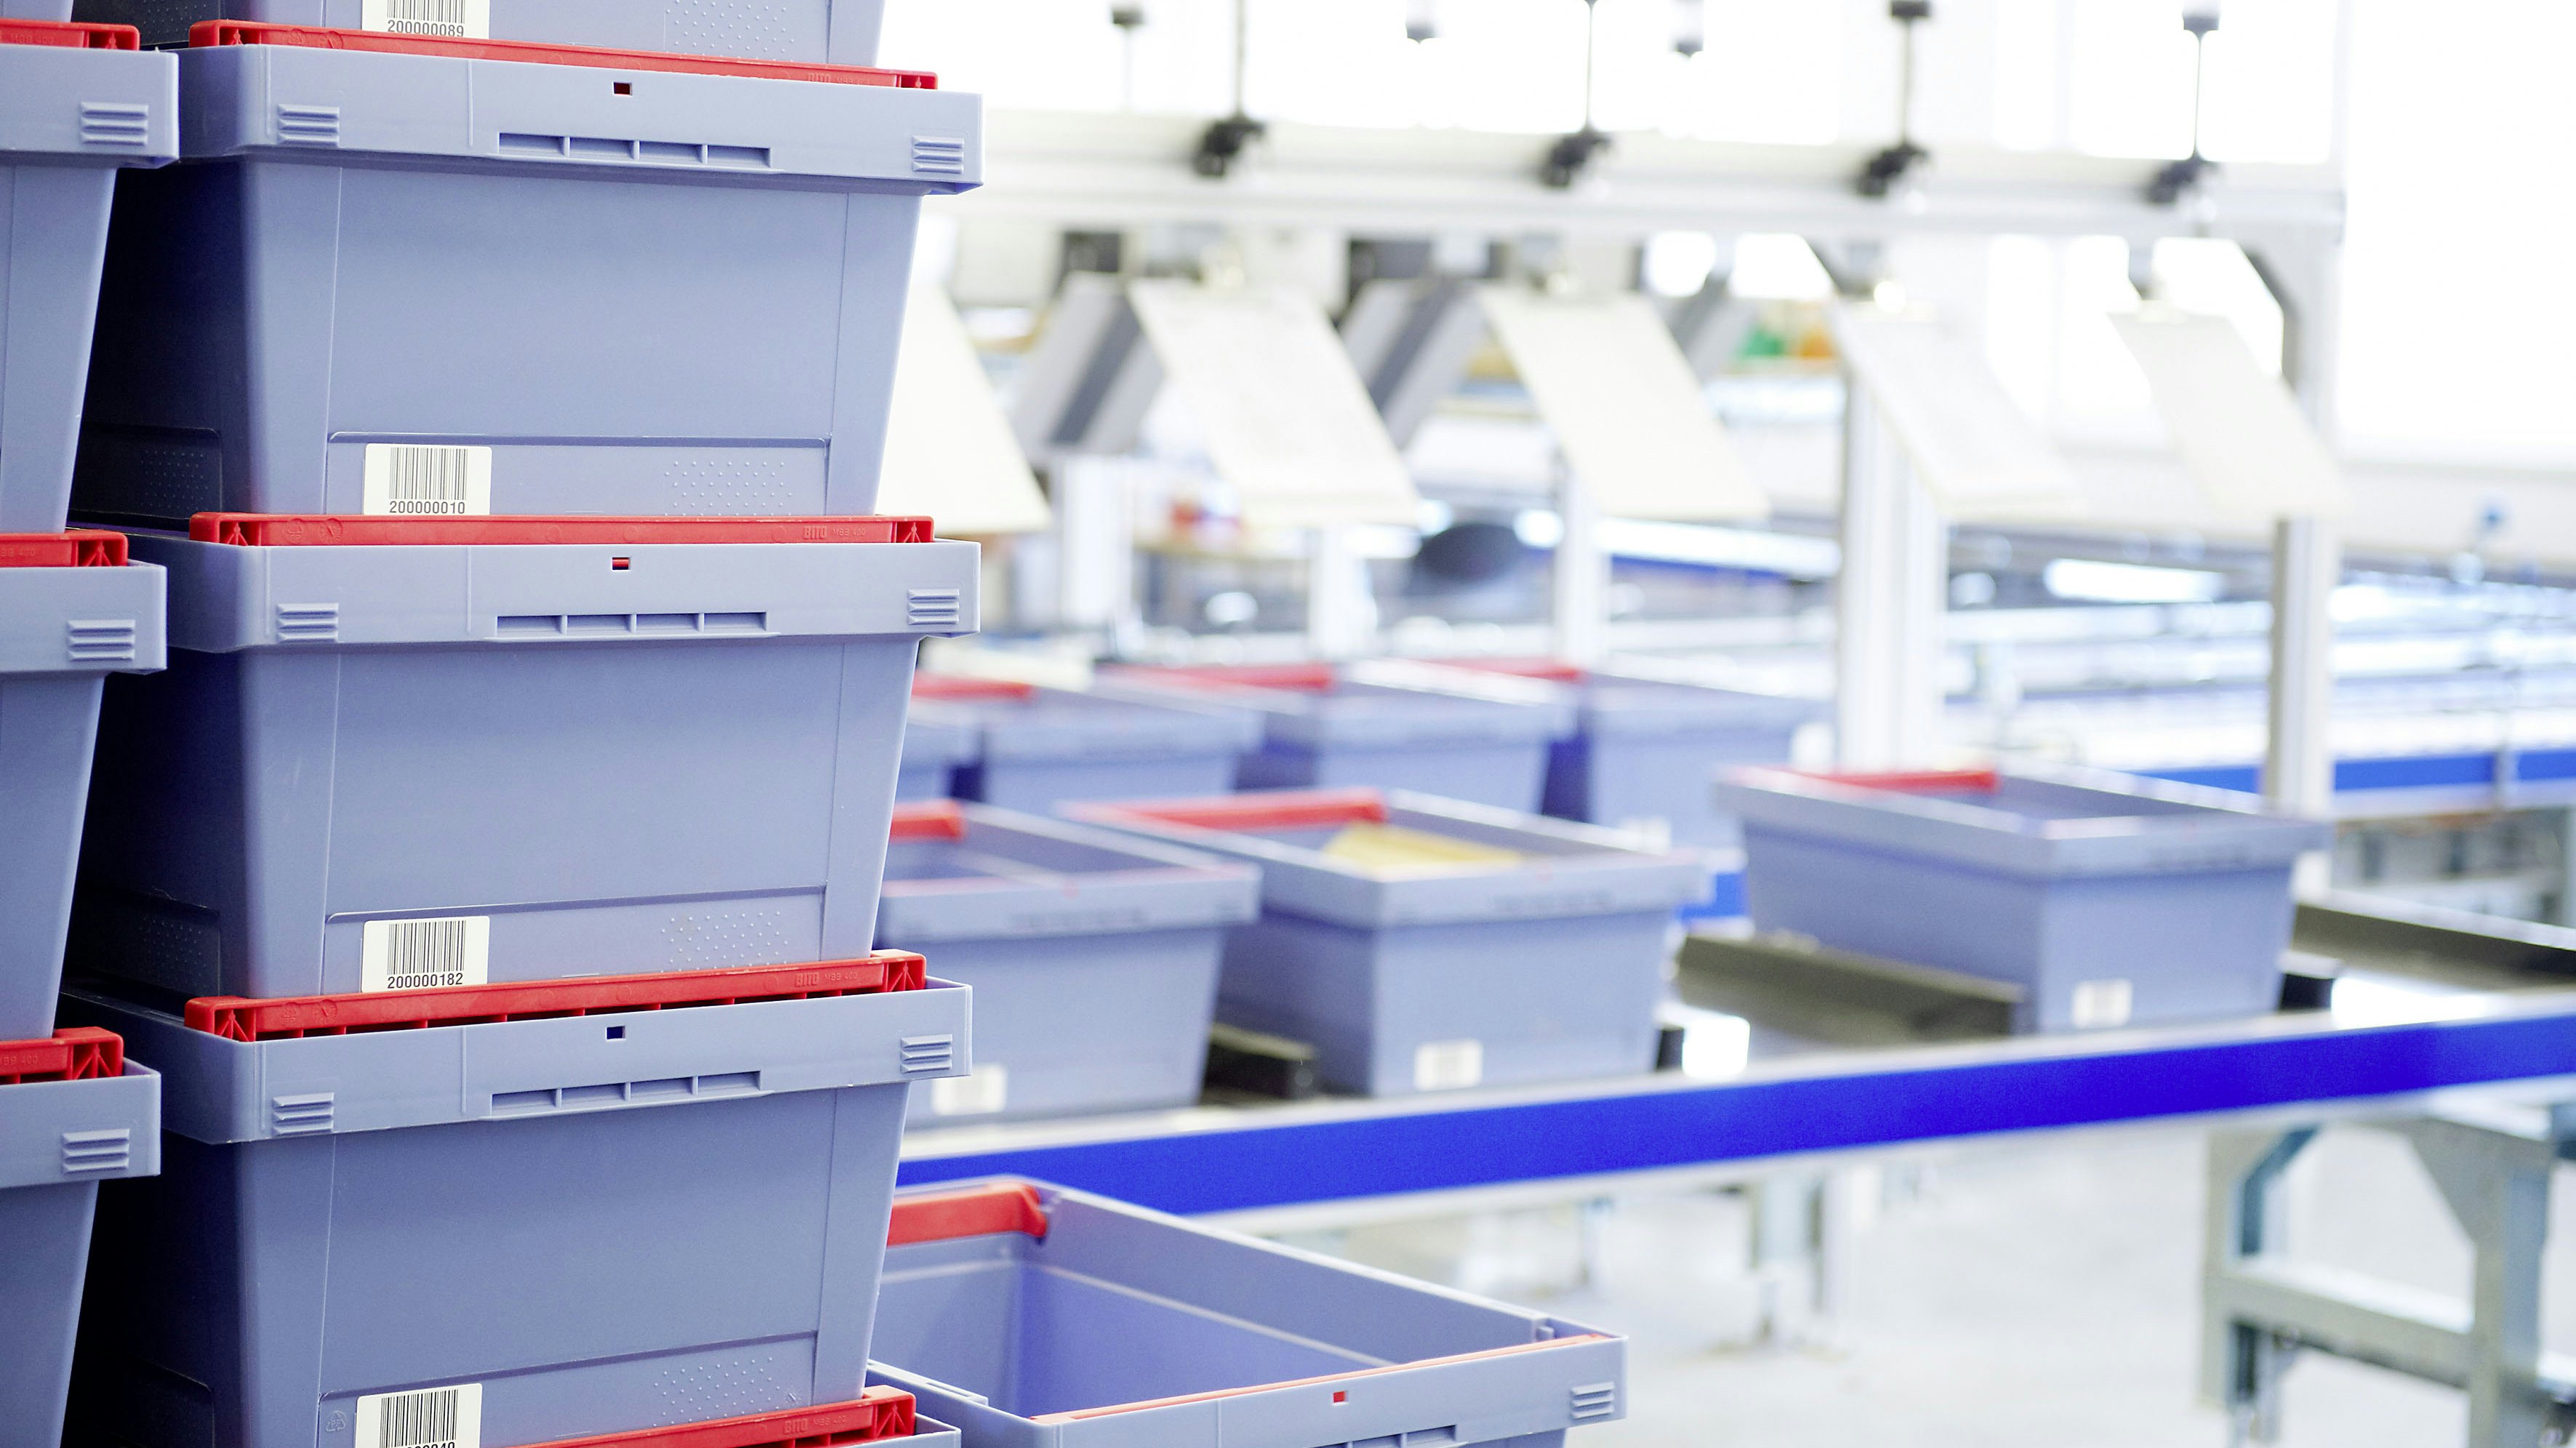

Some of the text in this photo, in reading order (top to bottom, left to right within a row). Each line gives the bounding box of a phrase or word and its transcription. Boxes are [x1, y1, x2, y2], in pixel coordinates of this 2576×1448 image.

[388, 20, 464, 37] 200000089
[389, 500, 465, 514] 200000010
[803, 526, 827, 540] BITO
[388, 973, 463, 989] 200000182
[795, 972, 819, 987] BITO
[783, 1418, 808, 1434] BITO
